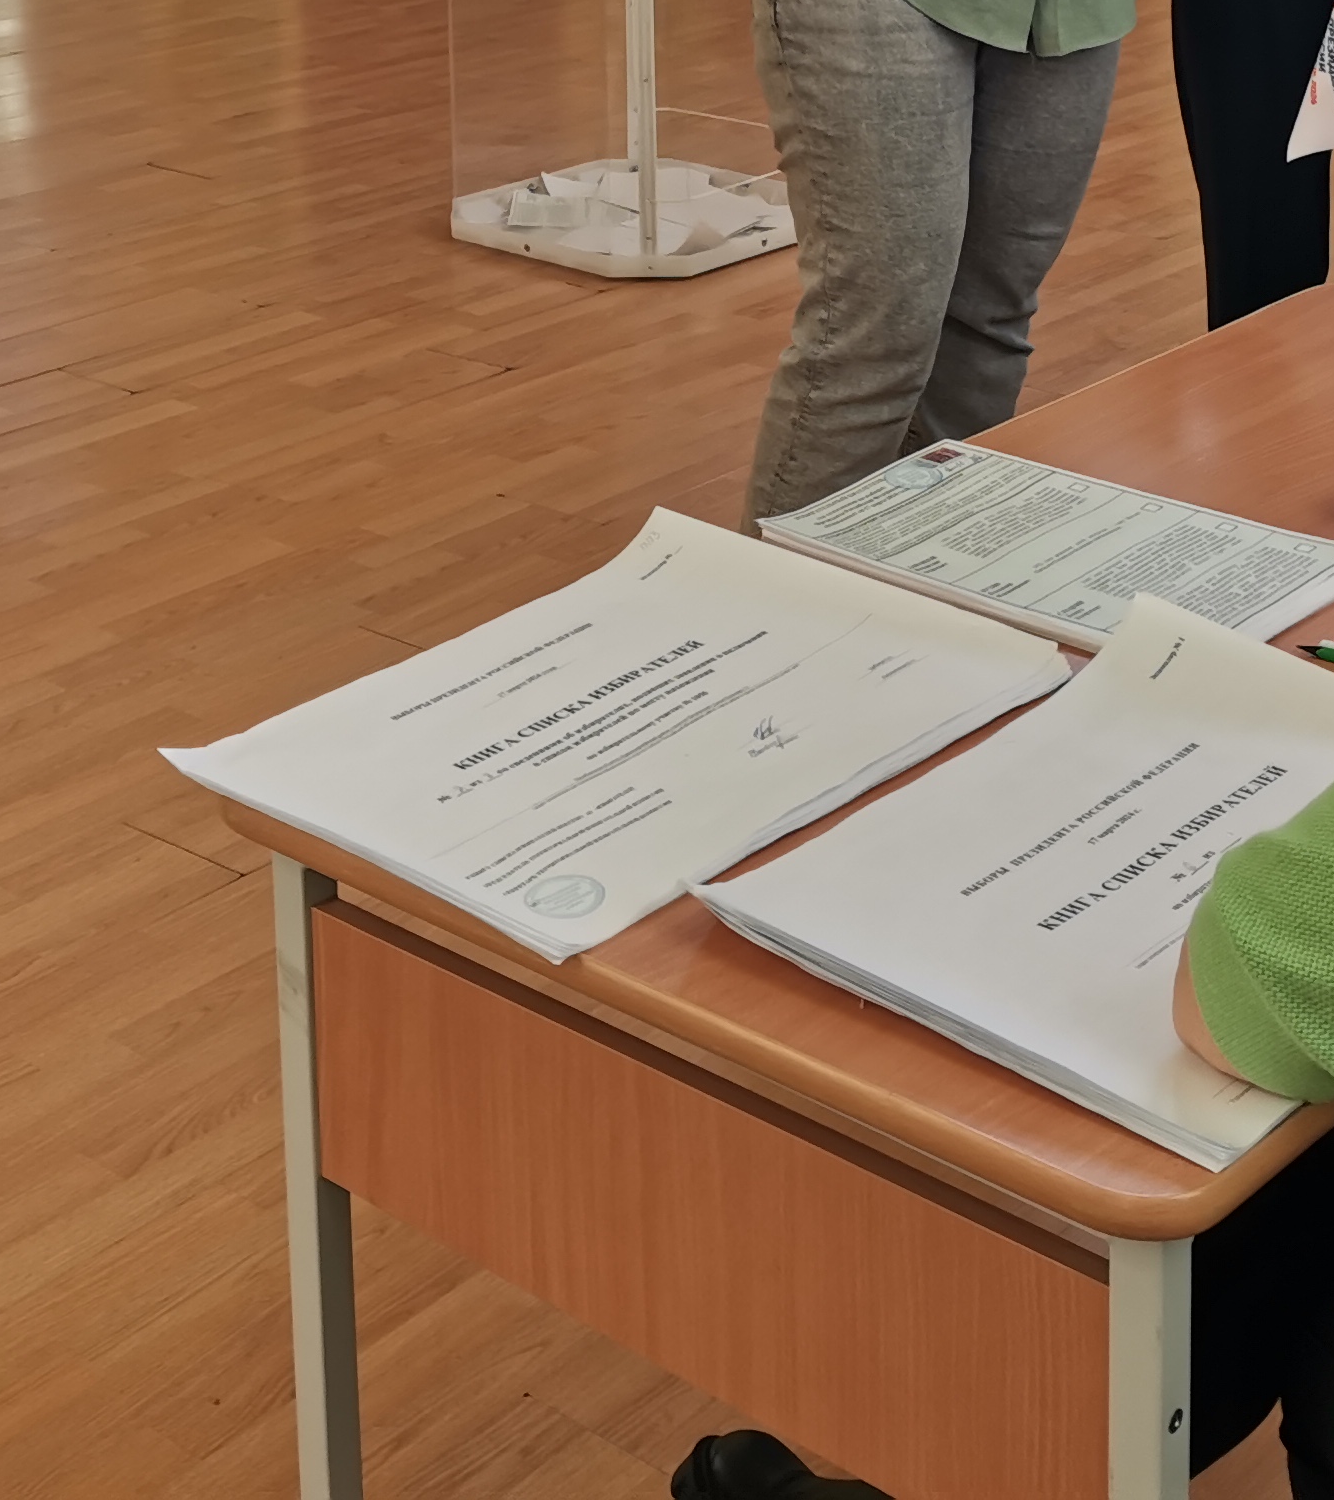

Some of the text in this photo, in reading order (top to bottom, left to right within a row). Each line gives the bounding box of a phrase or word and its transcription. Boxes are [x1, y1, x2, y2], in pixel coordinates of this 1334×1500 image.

[453, 738, 521, 770] КНИГА
[517, 700, 593, 738] СПИСКА
[587, 639, 706, 700] ИЗБИРАТЕЛЕЙ
[960, 742, 1201, 897] ВЫБОРЫ ПРЕЗИДЕНТА РОССИЙСКОЙ ФЕДЕРАЦИИ
[1037, 764, 1289, 931] КНИГА СПИСКА ИЗБИРАТЕЛЕЙ
